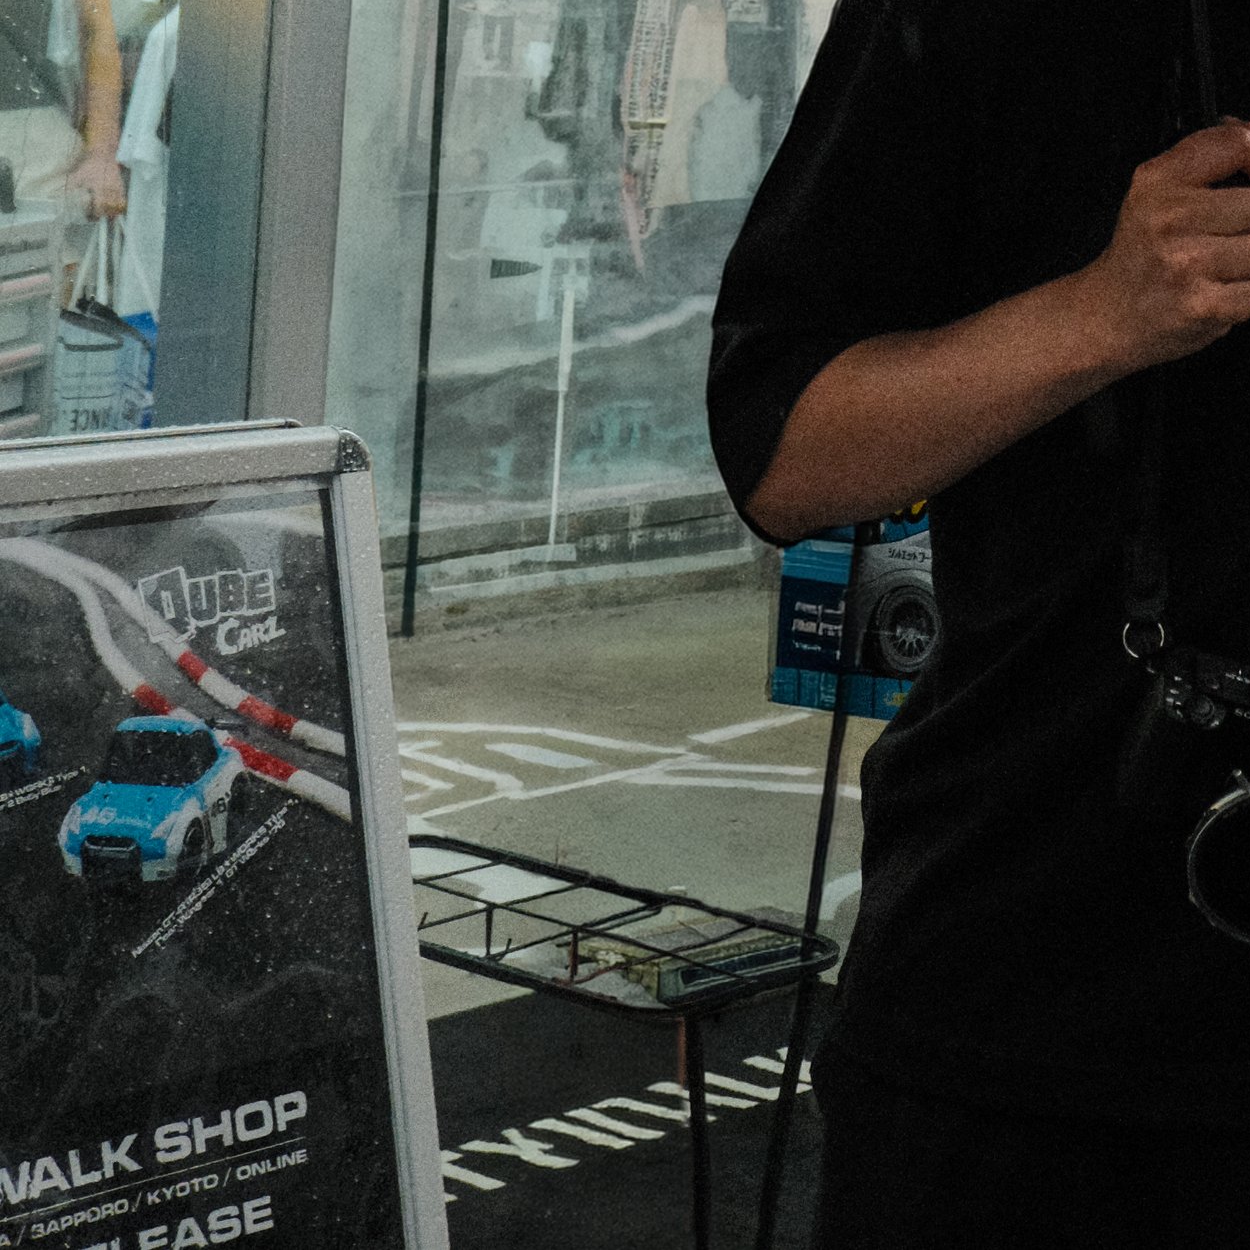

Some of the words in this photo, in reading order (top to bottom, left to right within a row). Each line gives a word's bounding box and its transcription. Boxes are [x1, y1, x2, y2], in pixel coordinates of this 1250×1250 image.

[0, 1133, 143, 1205] WALK
[154, 1090, 308, 1163] SHOP
[31, 1198, 129, 1239] SAPPORO
[147, 1173, 219, 1206] KYOTO
[236, 1149, 308, 1182] ONLINE
[82, 1195, 275, 1250] EASE
